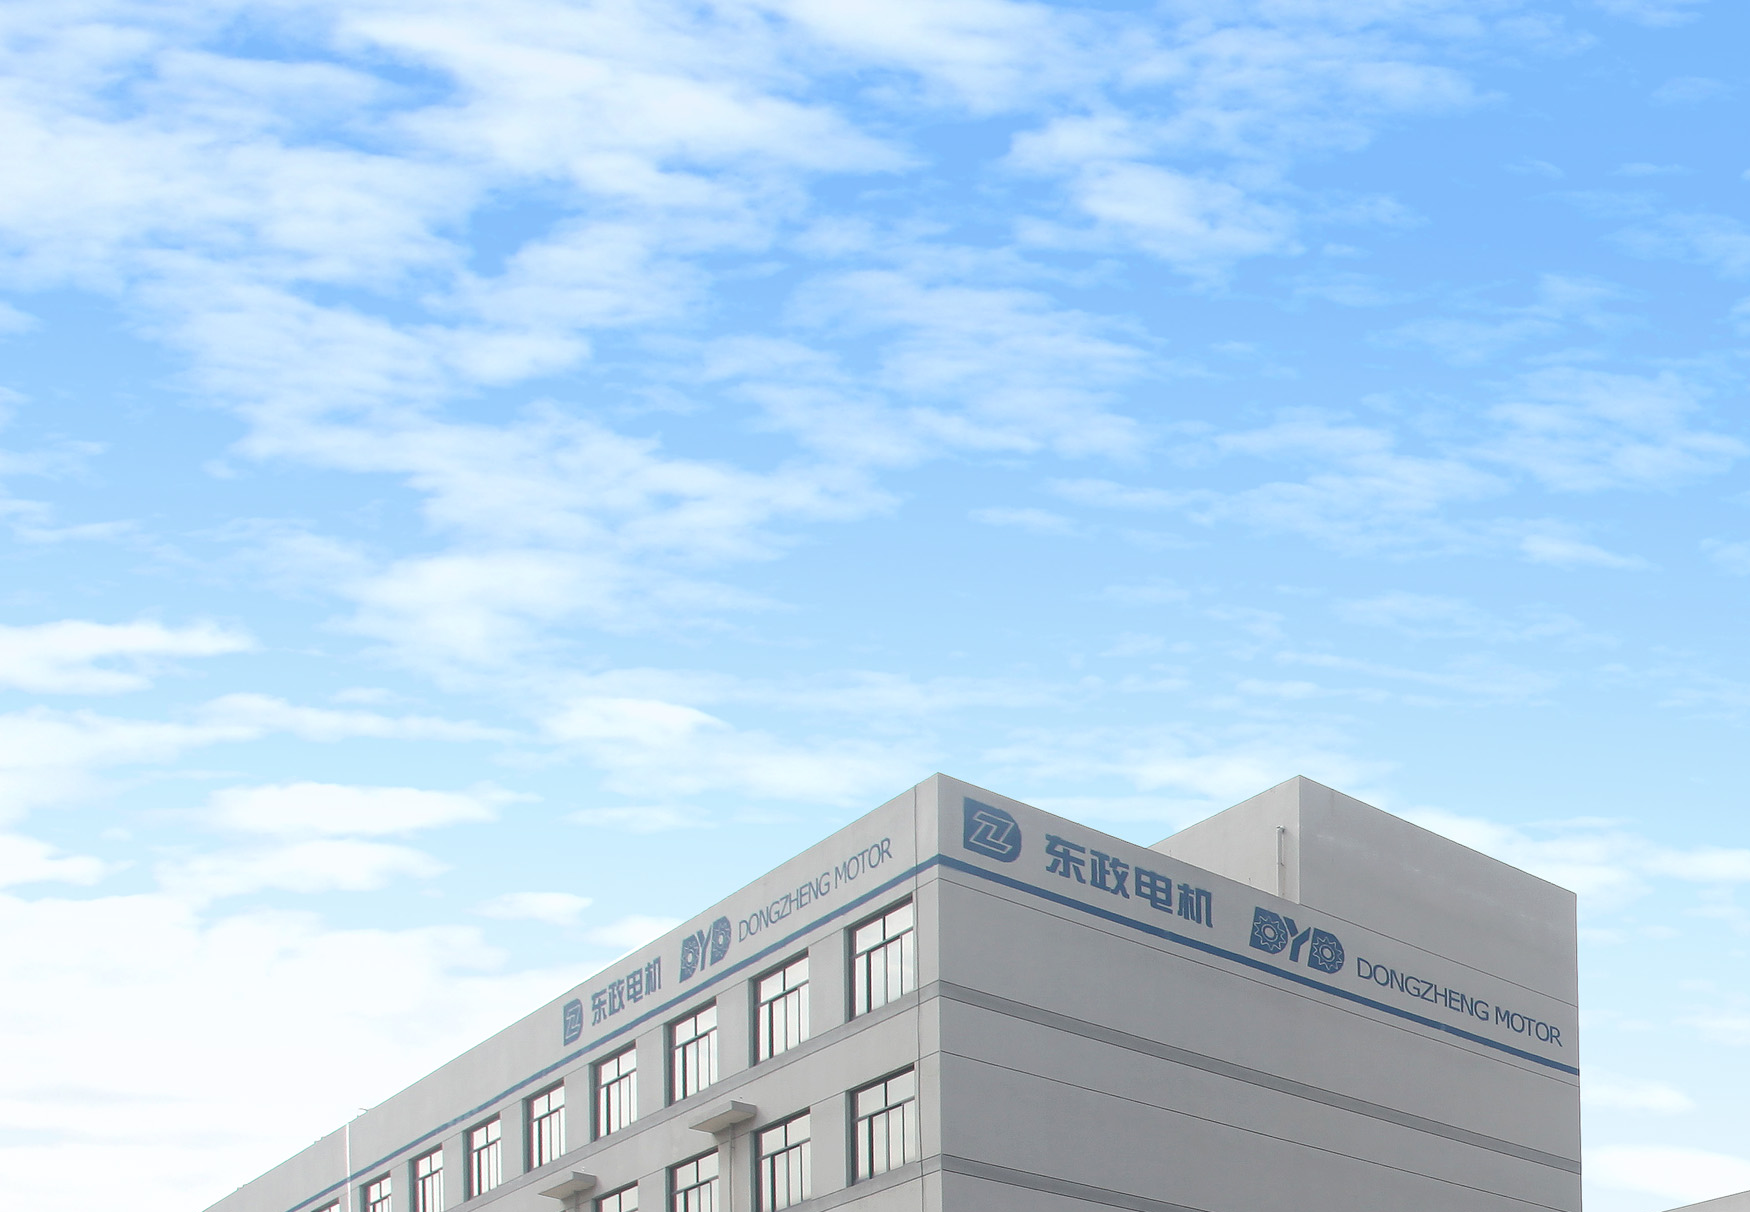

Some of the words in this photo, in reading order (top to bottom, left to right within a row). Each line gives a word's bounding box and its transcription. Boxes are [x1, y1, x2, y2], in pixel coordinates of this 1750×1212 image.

[738, 872, 831, 942] DONGZHENG
[834, 838, 893, 890] MOTOR
[1045, 834, 1213, 928] 东政电机
[679, 916, 732, 983] DYD
[1249, 906, 1345, 975] DYD
[591, 956, 661, 1026] 东政电机
[1356, 956, 1490, 1022] DONGZHENG
[1495, 1005, 1563, 1048] MOTOR
